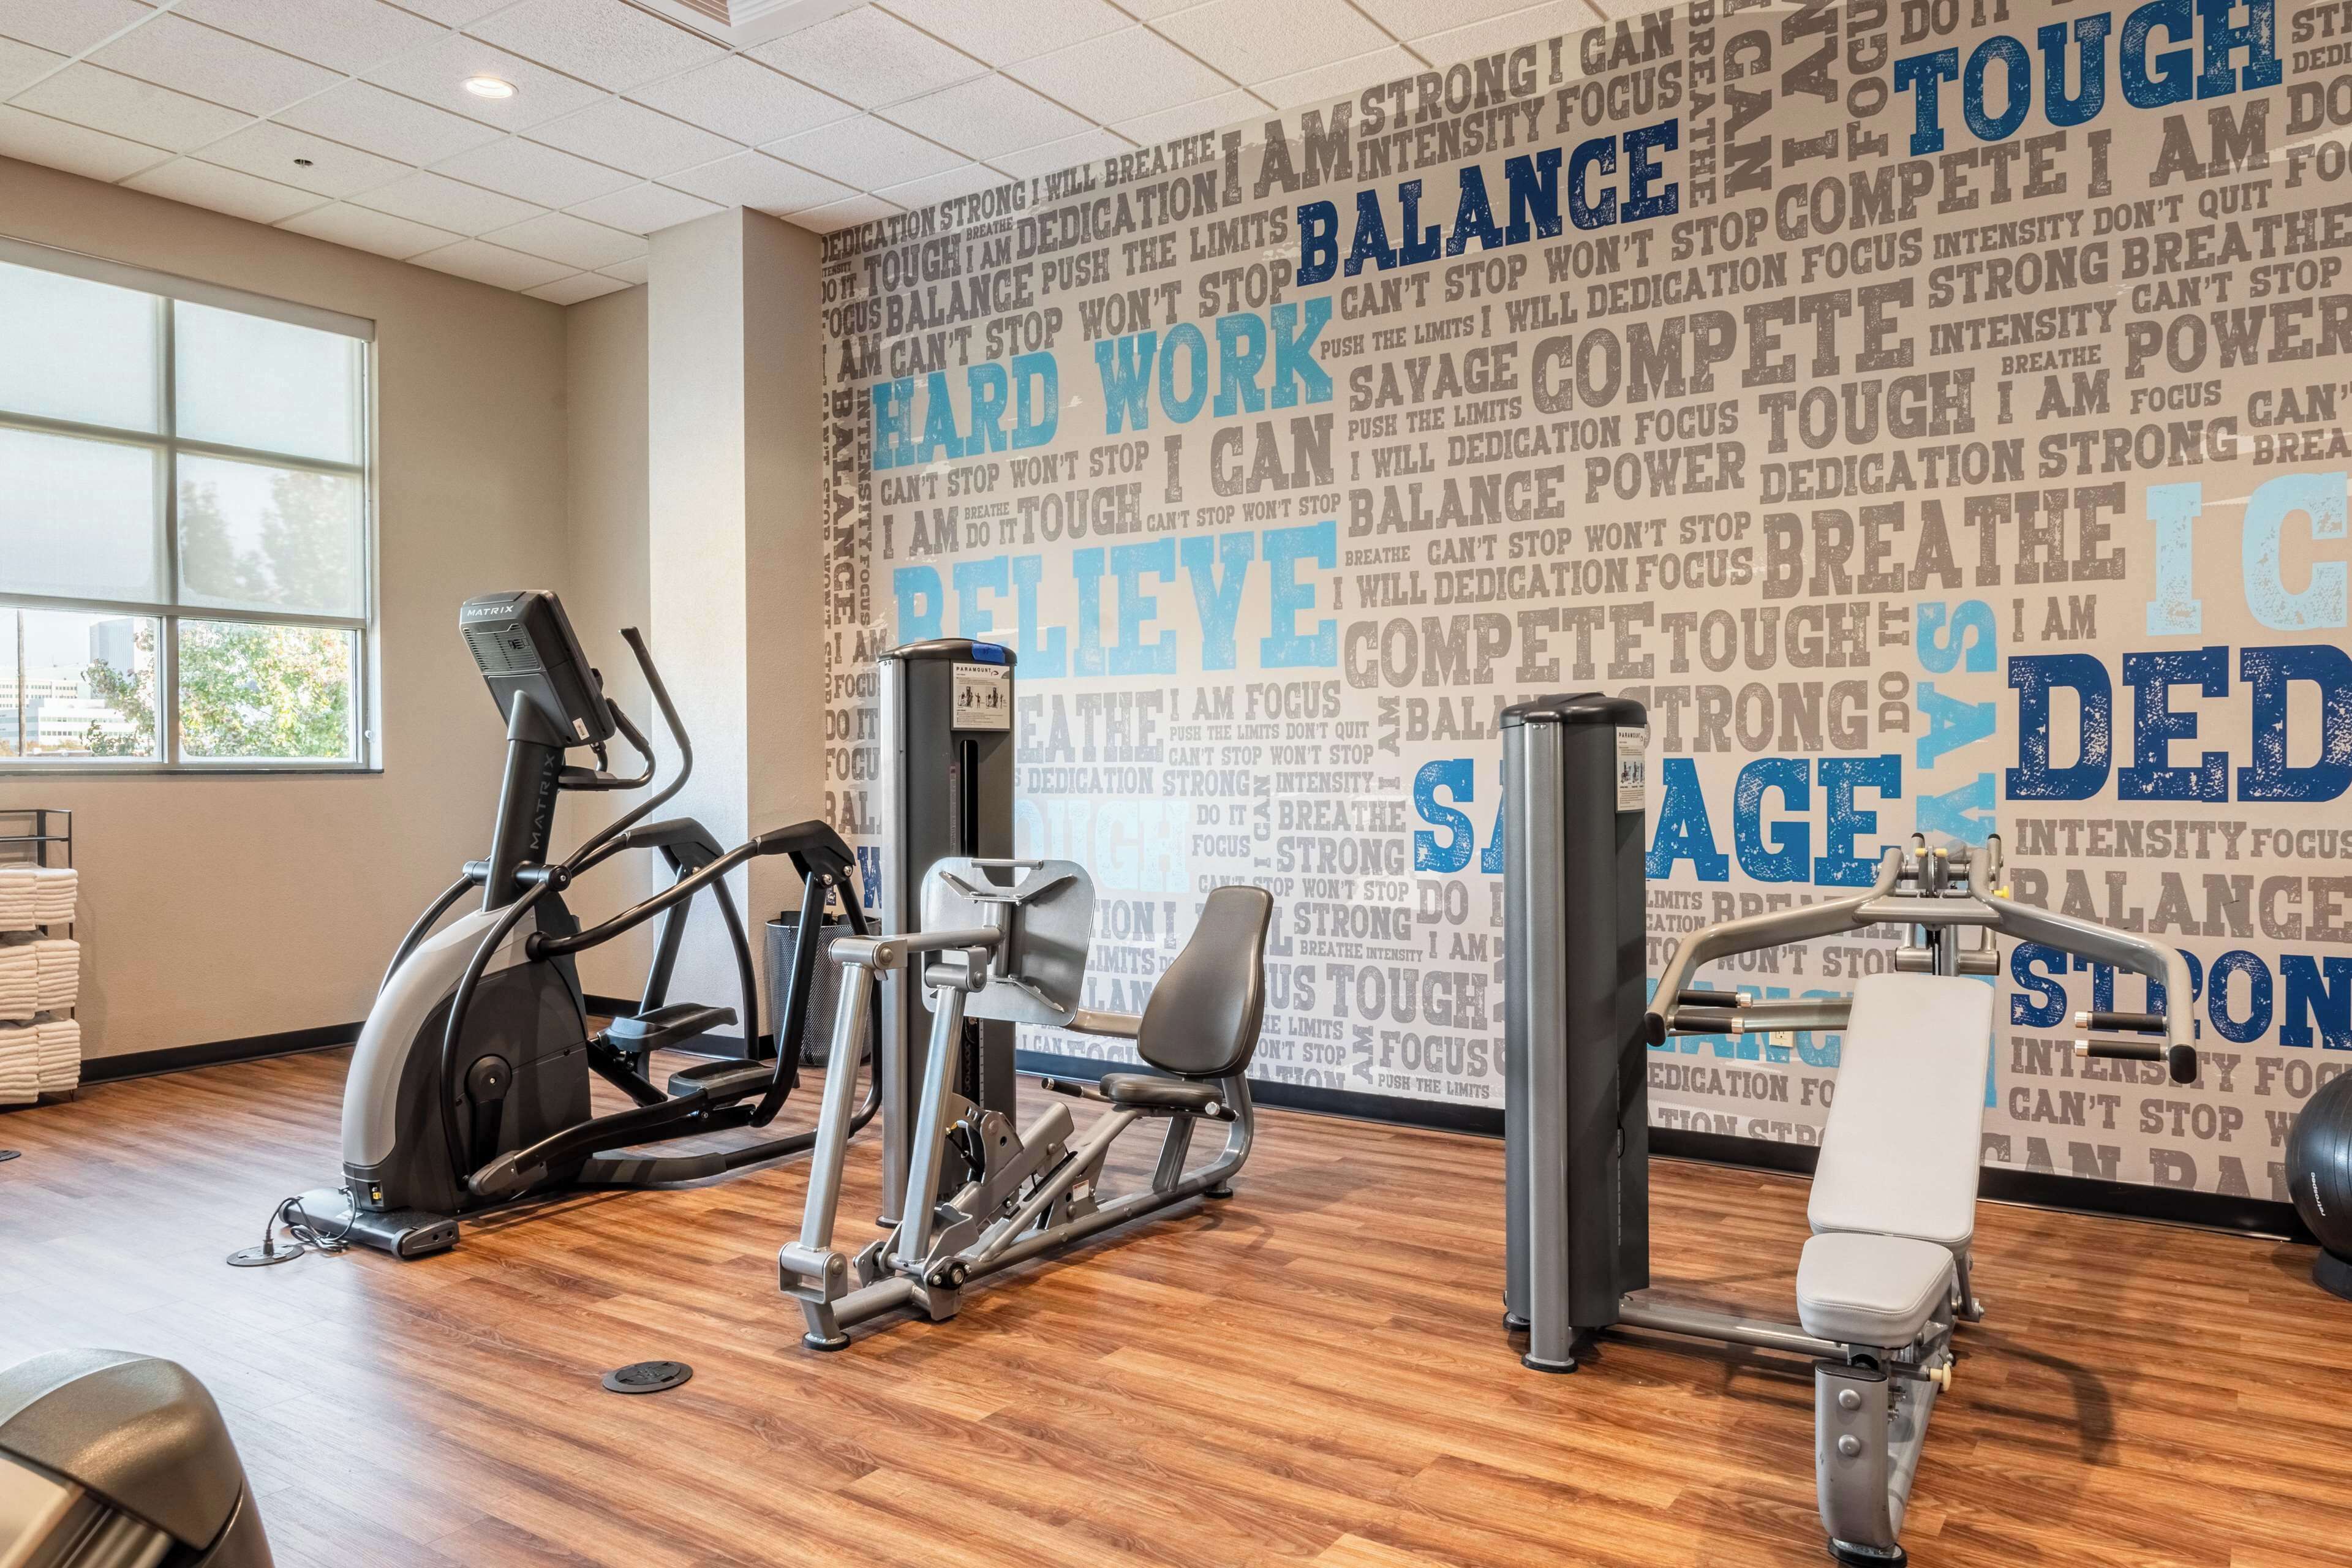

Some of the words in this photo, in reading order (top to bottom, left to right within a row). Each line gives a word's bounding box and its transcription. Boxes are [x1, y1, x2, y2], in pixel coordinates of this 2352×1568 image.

[1548, 36, 1562, 85] I
[1581, 8, 1674, 76] CAN
[1901, 0, 1959, 45] DO
[1360, 44, 1536, 138] STRONG
[1689, 0, 1716, 208] BREATHE
[1894, 0, 2282, 156] TOUGH
[1357, 96, 1545, 182] INTENSITY
[1556, 59, 1682, 134] FOCUS
[1724, 29, 1772, 198] CAN
[940, 181, 1025, 230] STRONG
[1045, 164, 1096, 202] WILL
[1104, 127, 1215, 189] BREATHE
[1222, 130, 1242, 208] I
[1254, 101, 1352, 200] AM
[1775, 130, 2067, 245] COMPETE
[2087, 129, 2111, 198] I
[2149, 98, 2269, 187] AM
[966, 217, 1012, 241] BREATHE
[1017, 169, 1217, 262] DEDICATION
[1297, 118, 1678, 287] BALANCE
[1934, 209, 2084, 260] INTENSITY
[2094, 194, 2183, 236] DON'T
[2199, 179, 2272, 220] QUIT
[864, 233, 961, 296] TOUGH
[886, 262, 1033, 337] BALANCE
[1042, 247, 1109, 295] PUSH
[1122, 231, 1176, 276] THE
[1190, 205, 1287, 262] LIMITS
[980, 236, 1011, 270] AM
[1341, 271, 1430, 320] CAN'T
[1445, 254, 1527, 302] STOP
[1544, 228, 1653, 284] WON'T
[1672, 207, 1768, 261] STOP
[1481, 304, 1491, 338] I
[1506, 291, 1577, 333] WILL
[1587, 252, 1787, 318] DEDICATION
[1801, 227, 1922, 284] FOCUS
[1929, 241, 2108, 309] STRONG
[2122, 199, 2352, 279] BREATHE
[840, 272, 857, 300] IT
[2132, 271, 2233, 314] CAN'T
[2250, 256, 2342, 298] STOP
[837, 337, 881, 383] AM
[890, 325, 971, 379] CAN'T
[986, 307, 1063, 360] STOP
[1079, 280, 1182, 341] WON'T
[1199, 258, 1292, 318] STOP
[1321, 334, 1364, 360] PUSH
[1372, 326, 1406, 351] THE
[1414, 315, 1474, 344] LIMITS
[1532, 274, 1913, 414] COMPETE
[1930, 299, 2117, 356] INTENSITY
[2125, 294, 2352, 380] POWER
[873, 350, 1058, 470] HARD
[1095, 295, 1333, 435] WORK
[1349, 341, 1518, 412] SAVAGE
[2002, 344, 2101, 375] BREATHE
[1348, 414, 1397, 441] PUSH
[1406, 407, 1444, 433] THE
[1454, 396, 1521, 427] LIMITS
[1758, 367, 1975, 454] TOUGH
[1997, 380, 2013, 424] I
[2036, 369, 2109, 420] AM
[2130, 379, 2221, 415] FOCUS
[1164, 434, 1182, 503] I
[1211, 413, 1333, 497] CAN
[1351, 451, 1359, 481] I
[1372, 442, 1434, 478] WILL
[1448, 415, 1621, 466] DEDICATION
[1635, 399, 1738, 445] FOCUS
[1760, 438, 2024, 504] DEDICATION
[2039, 416, 2237, 478] STRONG
[880, 473, 938, 506] CAN'T
[948, 463, 1000, 497] STOP
[1010, 450, 1079, 488] WON'T
[1090, 440, 1149, 477] STOP
[1349, 464, 1564, 537] BALANCE
[1585, 441, 1746, 503] POWER
[833, 388, 855, 624] BALANCE
[909, 506, 959, 557] AM
[965, 502, 1009, 520] BREATHE
[966, 521, 990, 548] DO
[999, 518, 1017, 545] IT
[1017, 482, 1142, 544] TOUGH
[1147, 510, 1189, 532] CAN'T
[1197, 505, 1235, 527] STOP
[1242, 498, 1291, 522] WON'T
[1299, 493, 1341, 516] STOP
[1346, 545, 1410, 566] BREATHE
[1428, 534, 1497, 565] CAN'T
[1509, 528, 1572, 559] STOP
[1585, 518, 1667, 552] WON'T
[1680, 511, 1751, 544] STOP
[1763, 481, 2125, 599] BREATHE
[2146, 481, 2202, 636] I
[860, 554, 870, 625] FOCUS
[1333, 576, 1343, 610] I
[1357, 570, 1427, 608] WILL
[1434, 557, 1628, 605] DEDICATION
[1635, 546, 1753, 592] FOCUS
[467, 605, 513, 617] MATRIX
[1661, 601, 1870, 673] TOUGH
[2013, 598, 2024, 642] I
[2041, 595, 2096, 641] AM
[1344, 601, 1654, 688] COMPETE
[858, 708, 878, 737] IT
[1193, 686, 1234, 720] AM
[1246, 680, 1341, 720] FOCUS
[1169, 747, 1214, 766] CAN'T
[1222, 746, 1262, 765] STOP
[1270, 745, 1322, 765] WON'T
[1330, 744, 1373, 764] STOP
[1170, 726, 1201, 741] PUSH
[1207, 725, 1231, 740] THE
[1237, 723, 1280, 739] LIMITS
[1286, 722, 1328, 740] DON'T
[1335, 721, 1369, 741] QUIT
[530, 752, 556, 850] MATRIX
[1026, 767, 1153, 794] DEDICATION
[1163, 769, 1250, 796] STRONG
[1276, 771, 1374, 793] INTENSITY
[1197, 804, 1220, 825] DO
[1229, 805, 1246, 826] IT
[1278, 800, 1406, 833] BREATHE
[2016, 819, 2247, 860] INTENSITY
[2251, 829, 2352, 859] FOCUS
[1192, 834, 1251, 858] FOCUS
[1277, 836, 1404, 875] STRONG
[1302, 878, 1355, 900] WON'T
[1364, 881, 1409, 902] STOP
[1417, 880, 1468, 925] DO
[2010, 867, 2352, 943] BALANCE
[1294, 902, 1411, 941] STRONG
[1300, 940, 1363, 959] BREATHE
[1366, 947, 1423, 962] INTENSITY
[1449, 932, 1487, 962] AM
[1327, 963, 1488, 1031] TOUGH
[1289, 1017, 1343, 1040] LIMITS
[1303, 1042, 1346, 1066] STOP
[1380, 1031, 1488, 1077] FOCUS
[1379, 1075, 1410, 1090] PUSH
[1416, 1078, 1441, 1093] THE
[1447, 1082, 1489, 1099] LIMITS
[2009, 1087, 2120, 1129] CAN'T
[2140, 1099, 2243, 1142] STOP
